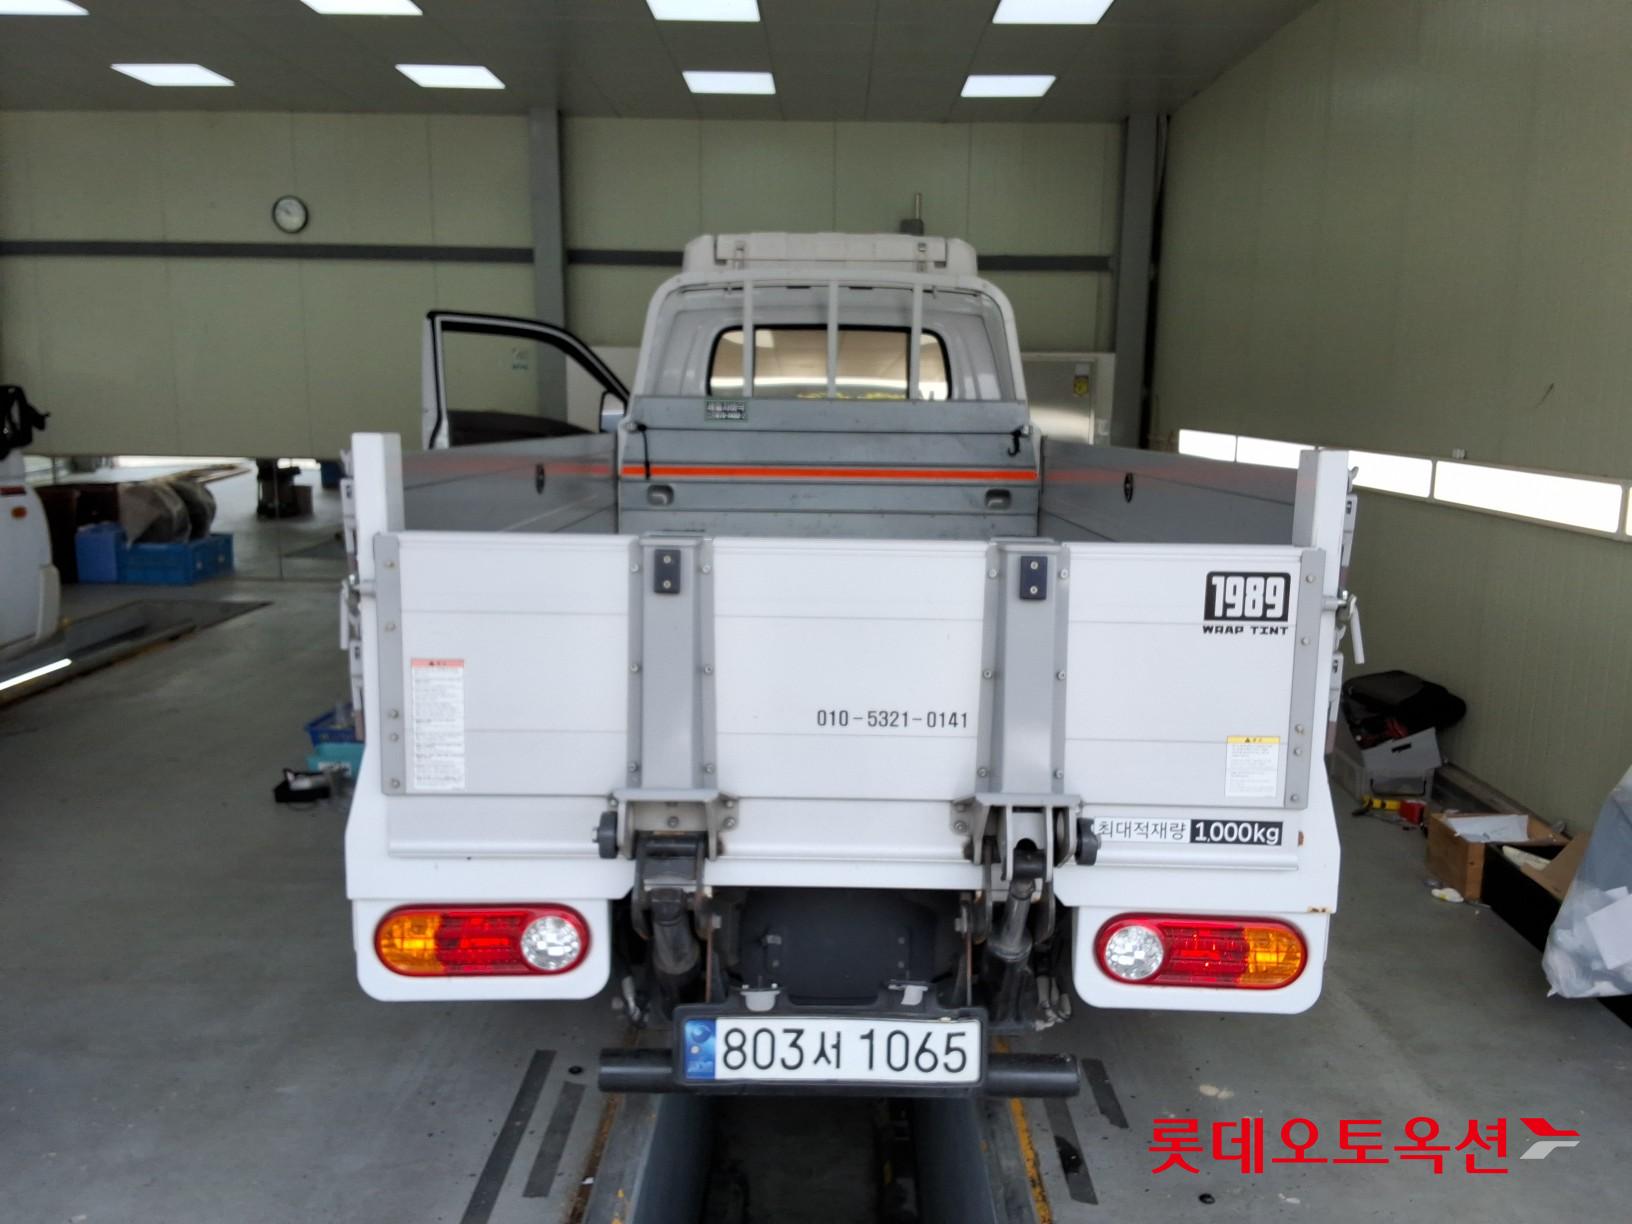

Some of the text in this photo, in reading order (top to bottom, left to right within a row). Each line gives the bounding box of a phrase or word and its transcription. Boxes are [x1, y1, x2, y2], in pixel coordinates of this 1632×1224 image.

[1211, 575, 1285, 618] 1989
[1202, 625, 1289, 635] WRAP TINT
[816, 709, 968, 729] 010-5321-0141
[1098, 819, 1280, 845] 최대적재량 1,000kg
[722, 1027, 967, 1073] 803서 1065
